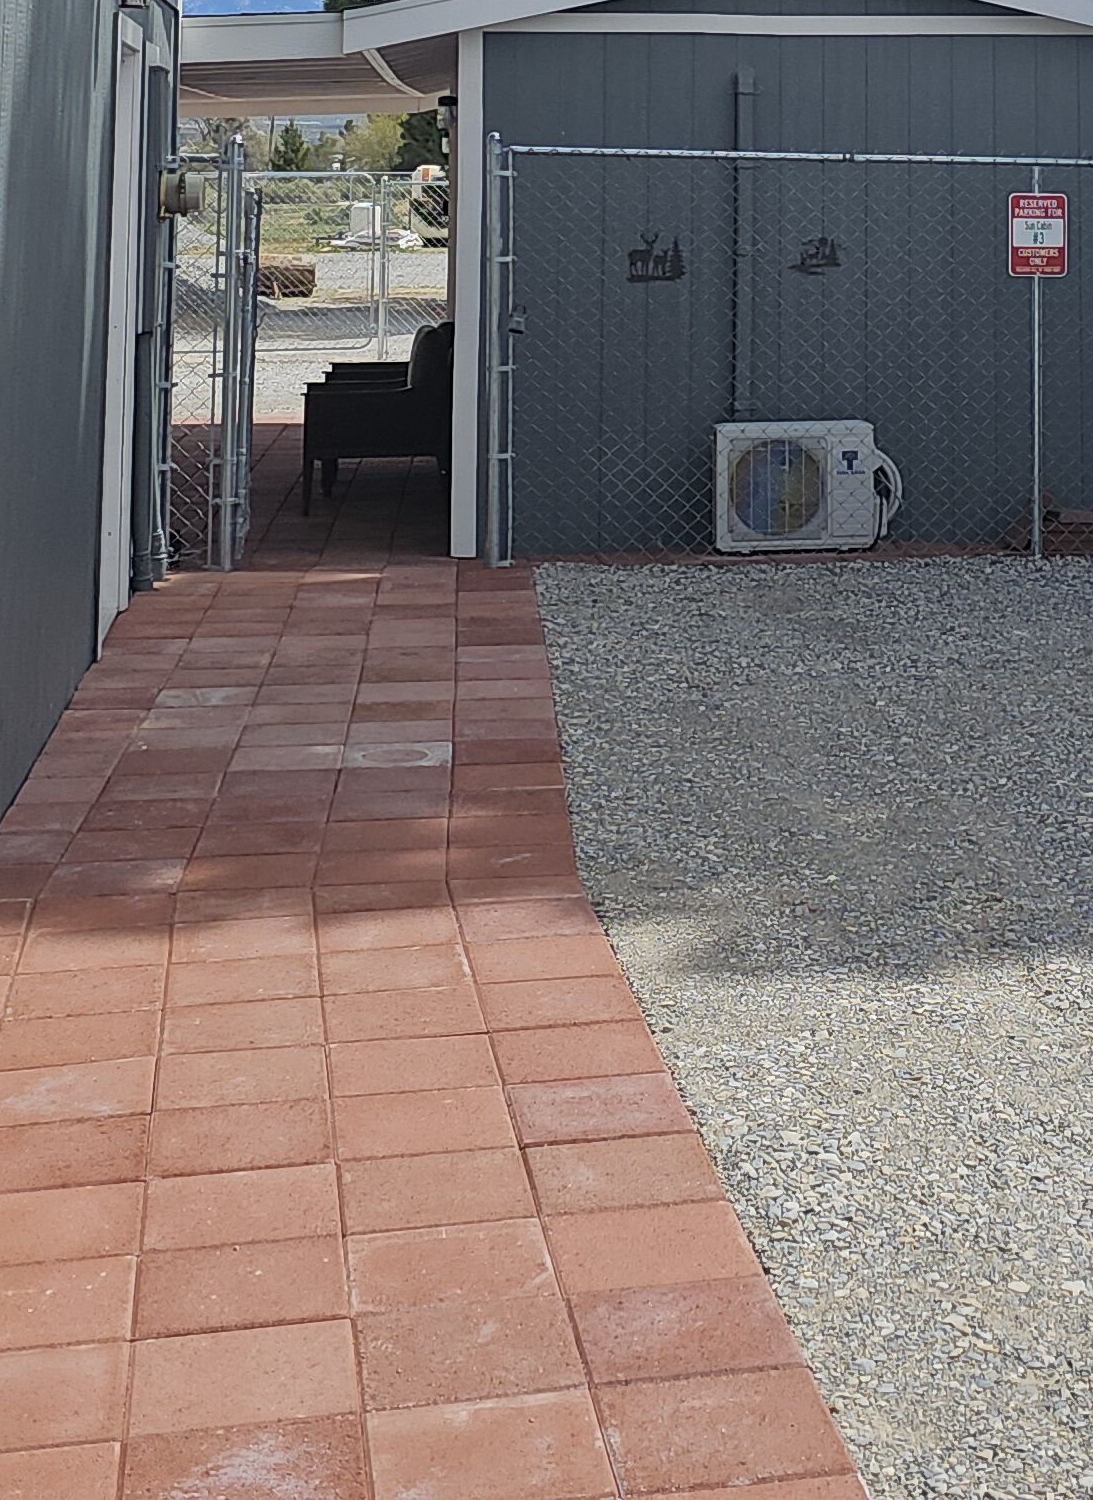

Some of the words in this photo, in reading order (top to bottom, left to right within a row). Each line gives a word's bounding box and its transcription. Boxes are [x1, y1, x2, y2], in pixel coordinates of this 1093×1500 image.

[1019, 199, 1058, 208] RESERVED
[1014, 208, 1045, 217] PARKING
[1047, 208, 1063, 217] FOR
[1032, 231, 1045, 245] #3
[1017, 248, 1059, 257] CUSTOMERS
[1028, 257, 1048, 266] ONLY
